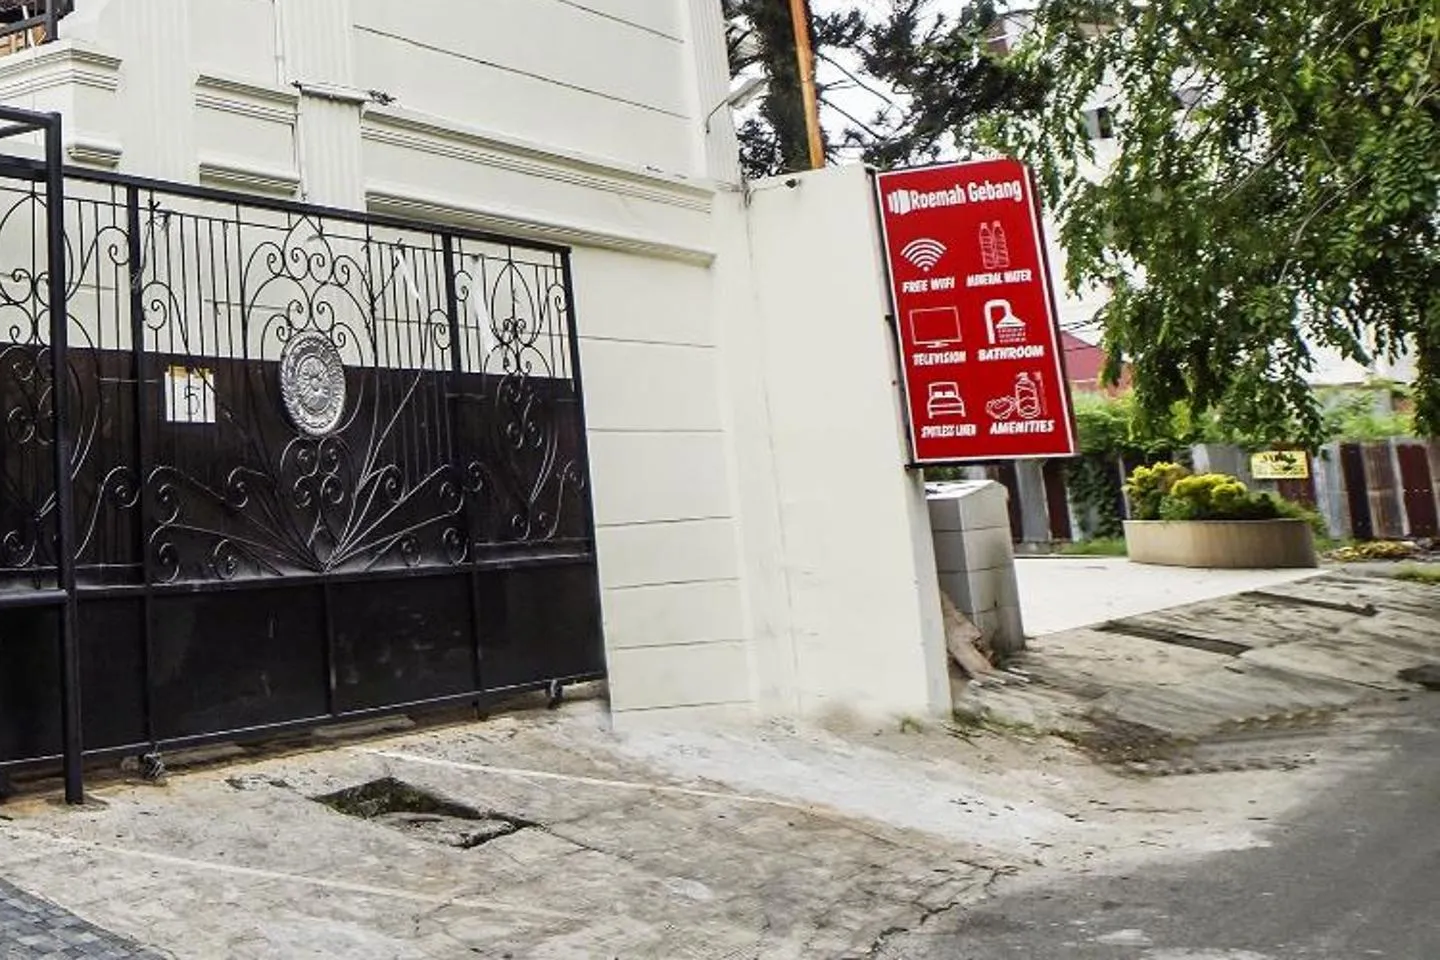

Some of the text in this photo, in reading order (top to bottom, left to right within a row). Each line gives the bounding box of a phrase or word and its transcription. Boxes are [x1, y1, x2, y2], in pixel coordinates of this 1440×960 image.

[910, 180, 1022, 210] Roemah Gebang
[1004, 269, 1032, 283] WATER
[902, 277, 955, 293] FREE WIFI
[912, 351, 966, 366] TELEVISION
[978, 345, 1045, 361] BATHROOM
[990, 420, 1055, 435] AMENITIES
